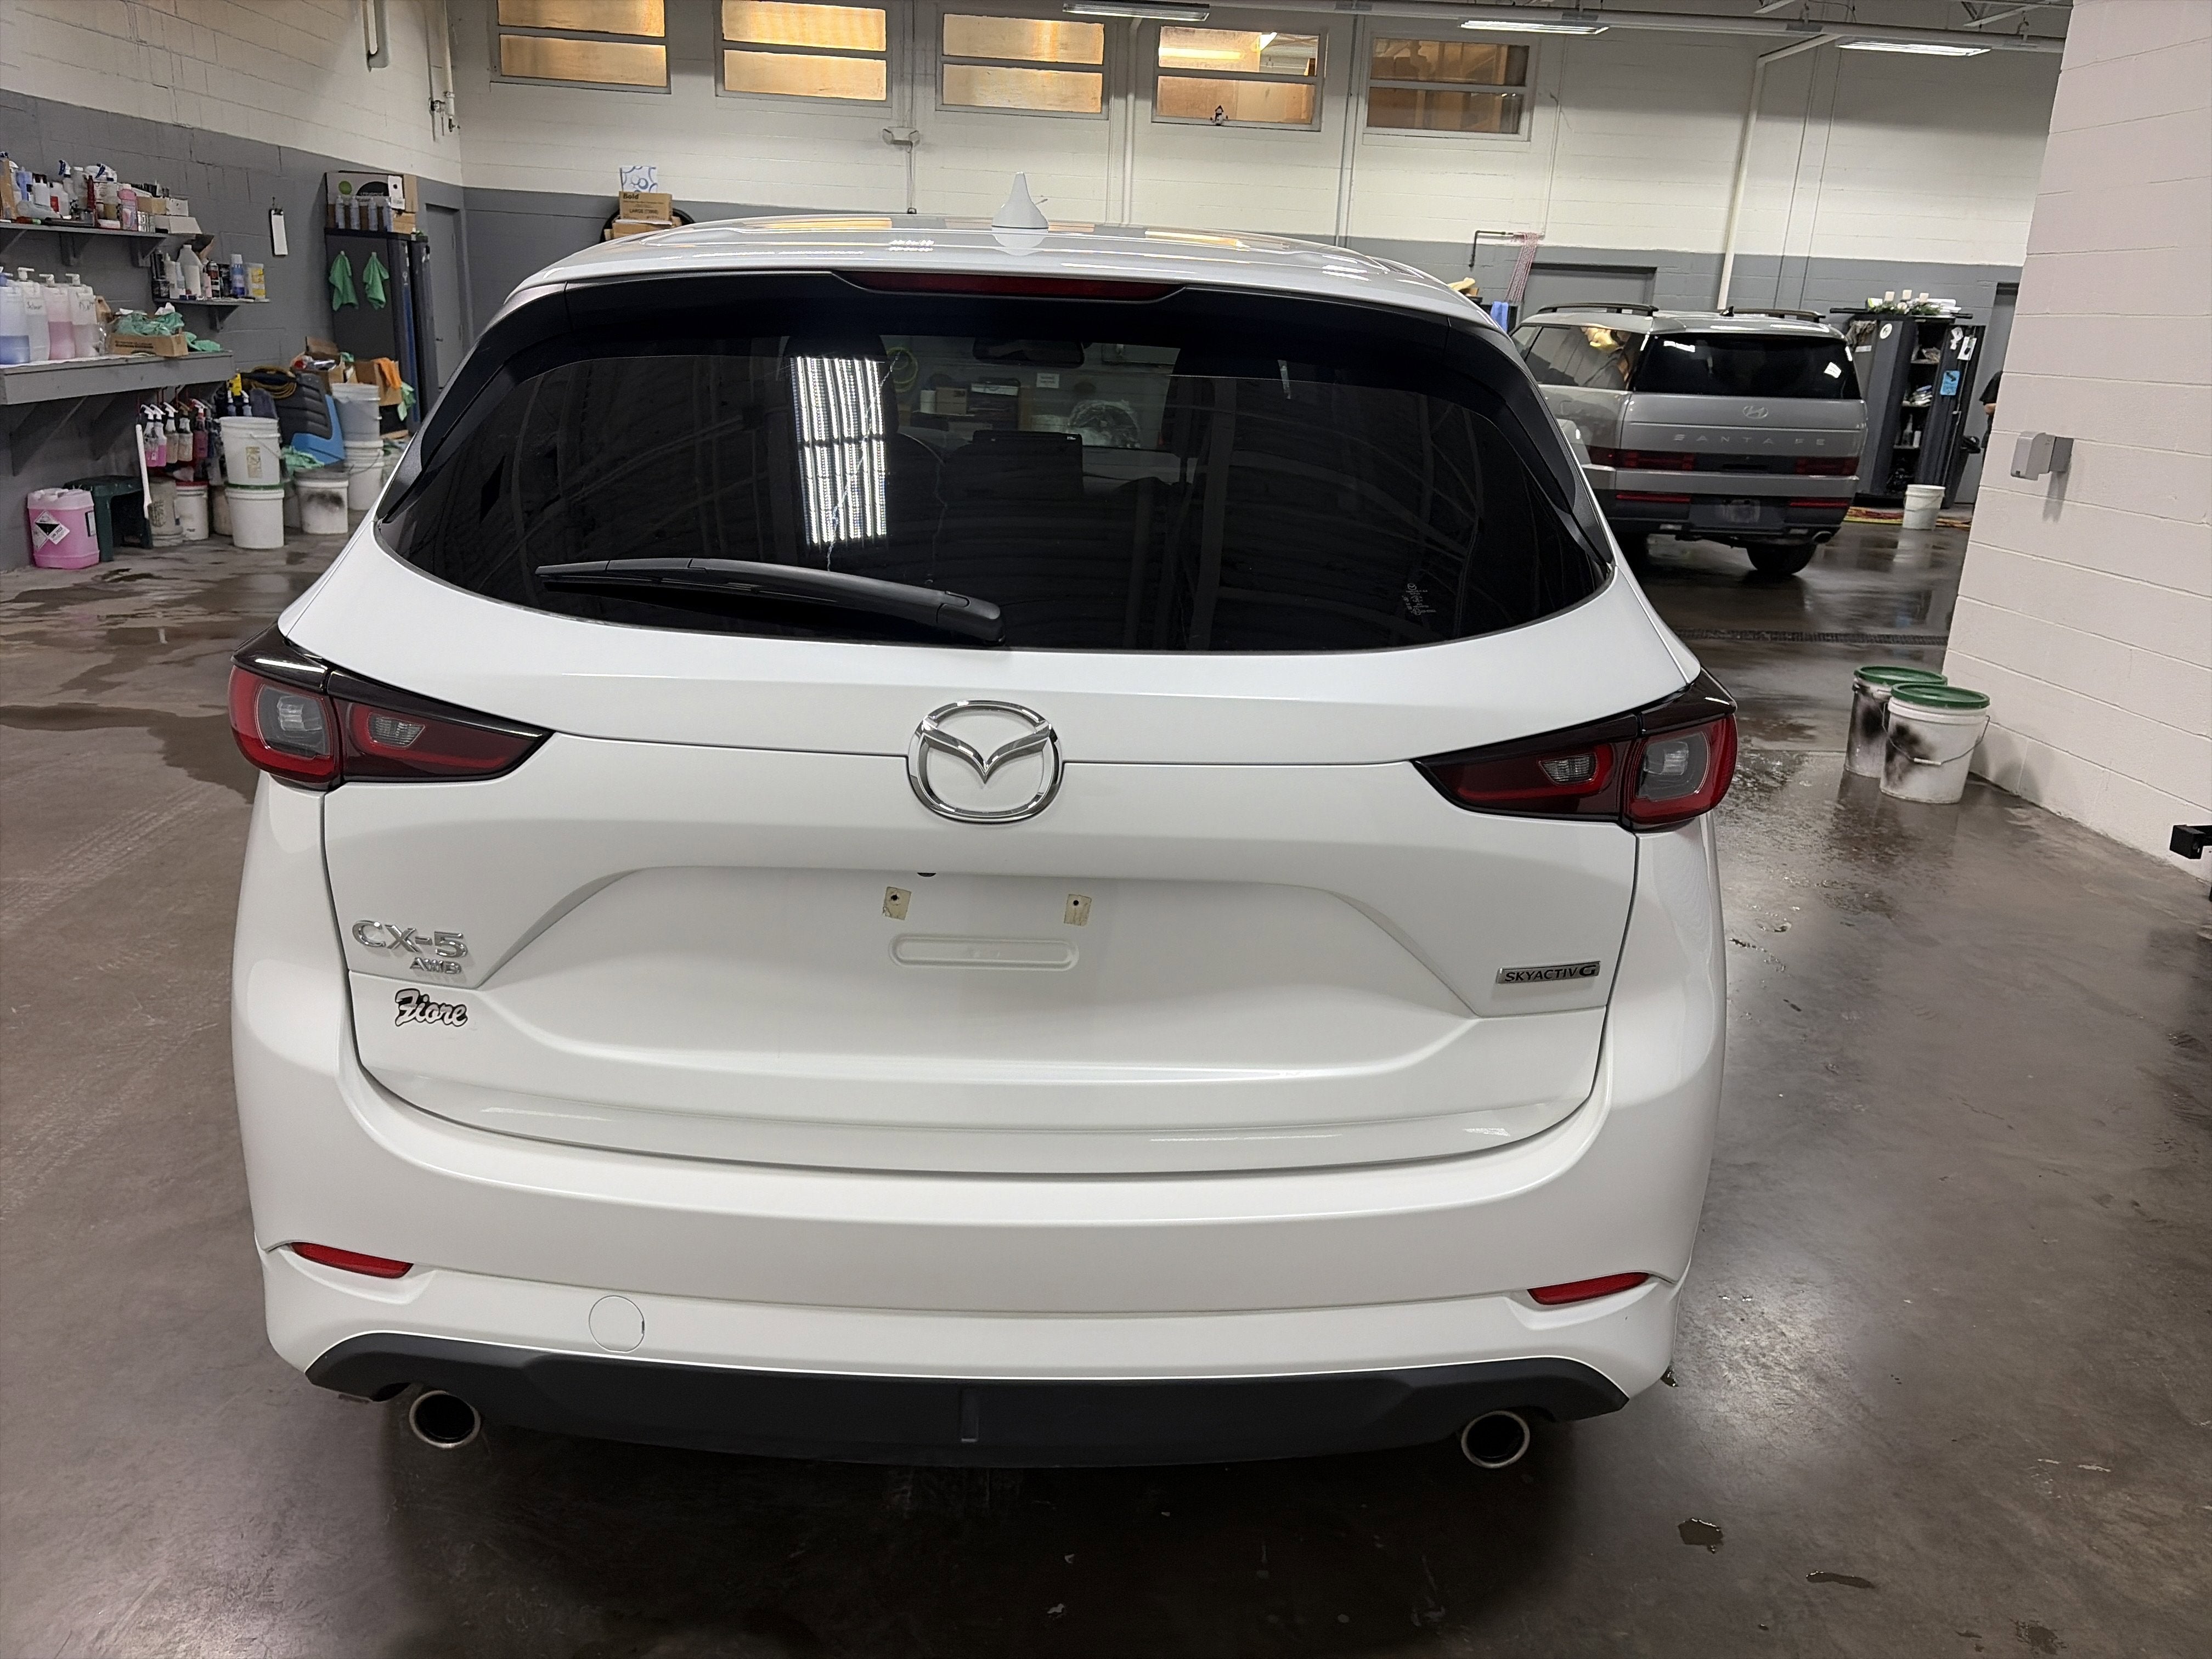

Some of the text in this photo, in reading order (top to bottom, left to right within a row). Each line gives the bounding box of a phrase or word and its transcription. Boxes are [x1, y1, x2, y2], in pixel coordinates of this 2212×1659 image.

[1673, 433, 1826, 446] SANTA FE
[352, 919, 468, 958] CX-5
[410, 957, 461, 974] AWD
[394, 988, 468, 1027] Fiore
